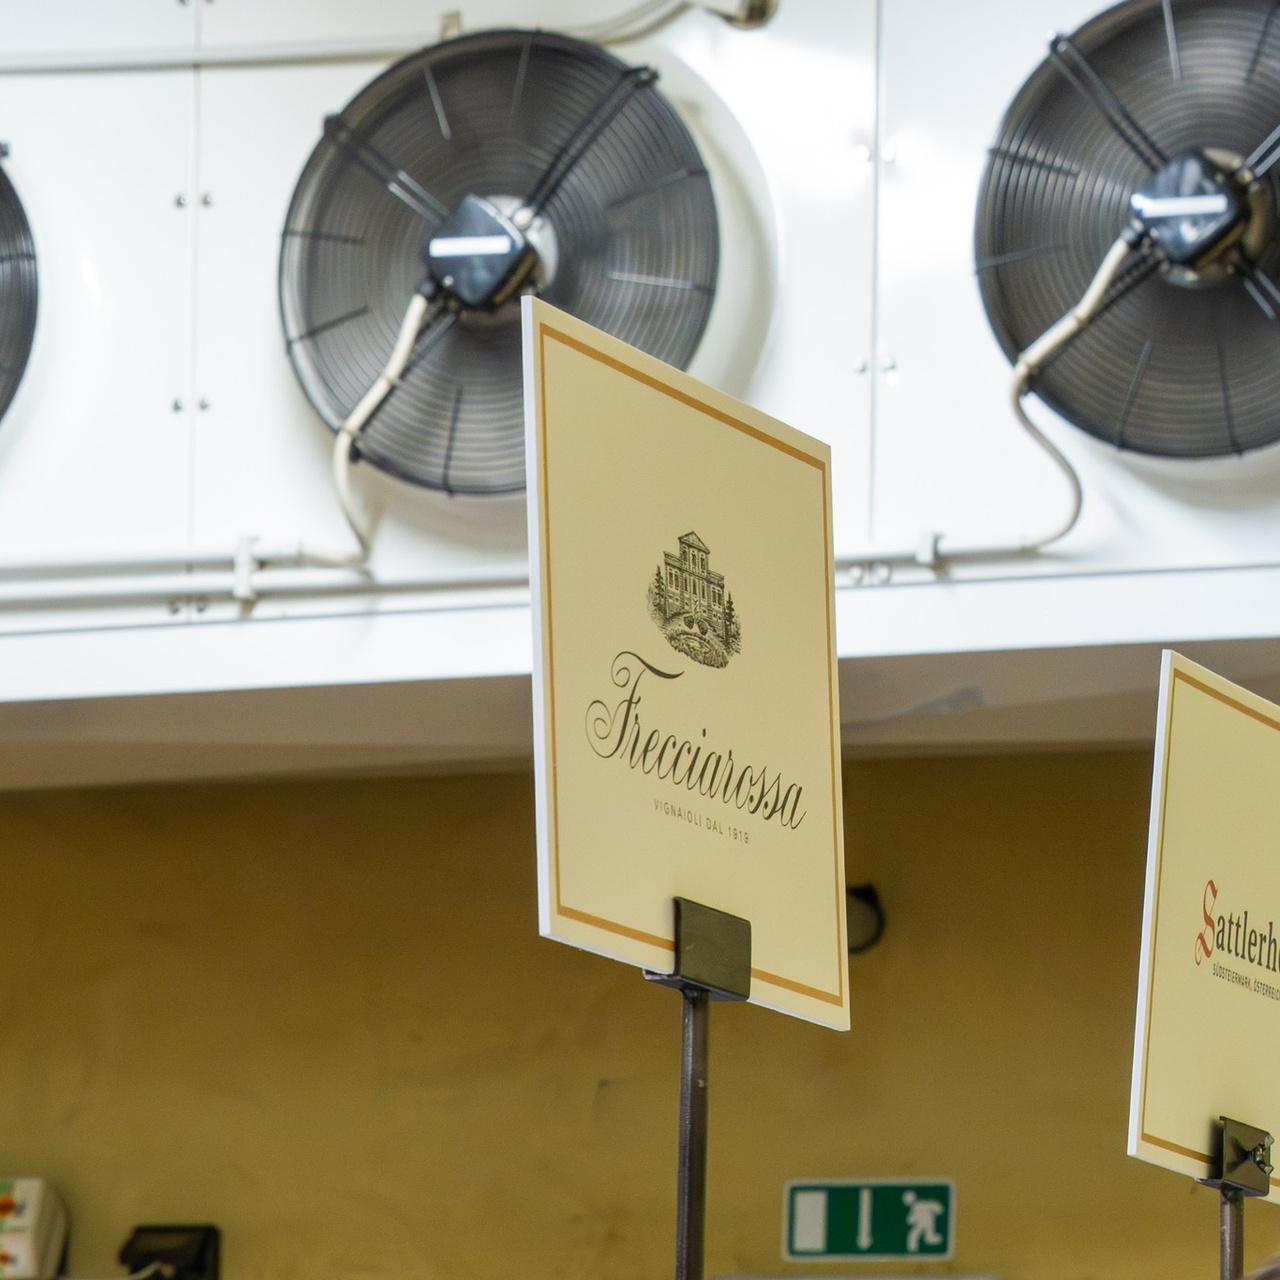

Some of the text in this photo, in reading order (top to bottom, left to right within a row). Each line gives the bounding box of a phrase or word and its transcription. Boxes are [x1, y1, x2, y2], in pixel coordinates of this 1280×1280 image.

[585, 651, 807, 830] Frecciarossa
[653, 798, 749, 845] VIGNAIOLI DAL 1919
[1194, 879, 1280, 974] Sattlerh
